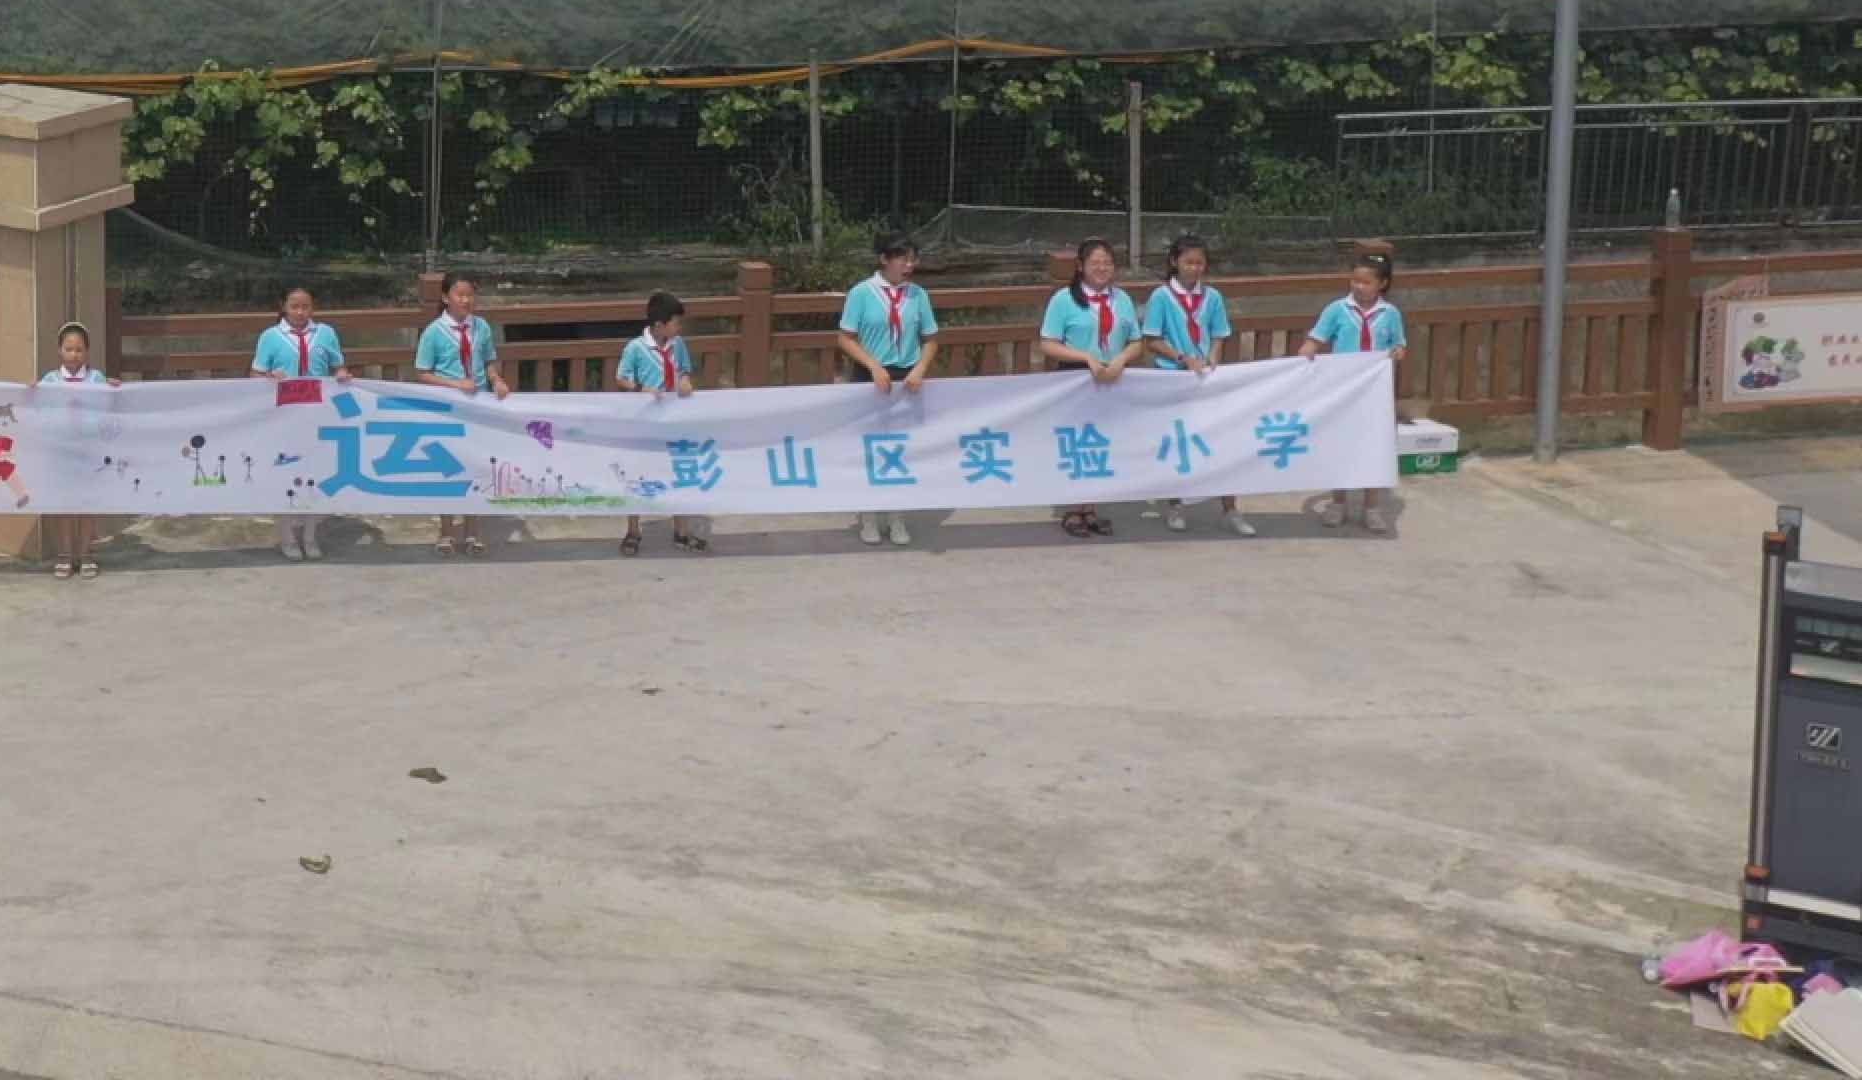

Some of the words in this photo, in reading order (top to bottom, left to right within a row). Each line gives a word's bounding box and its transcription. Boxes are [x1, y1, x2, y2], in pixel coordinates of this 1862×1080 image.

[668, 414, 1311, 490] 彭山区实验小学
